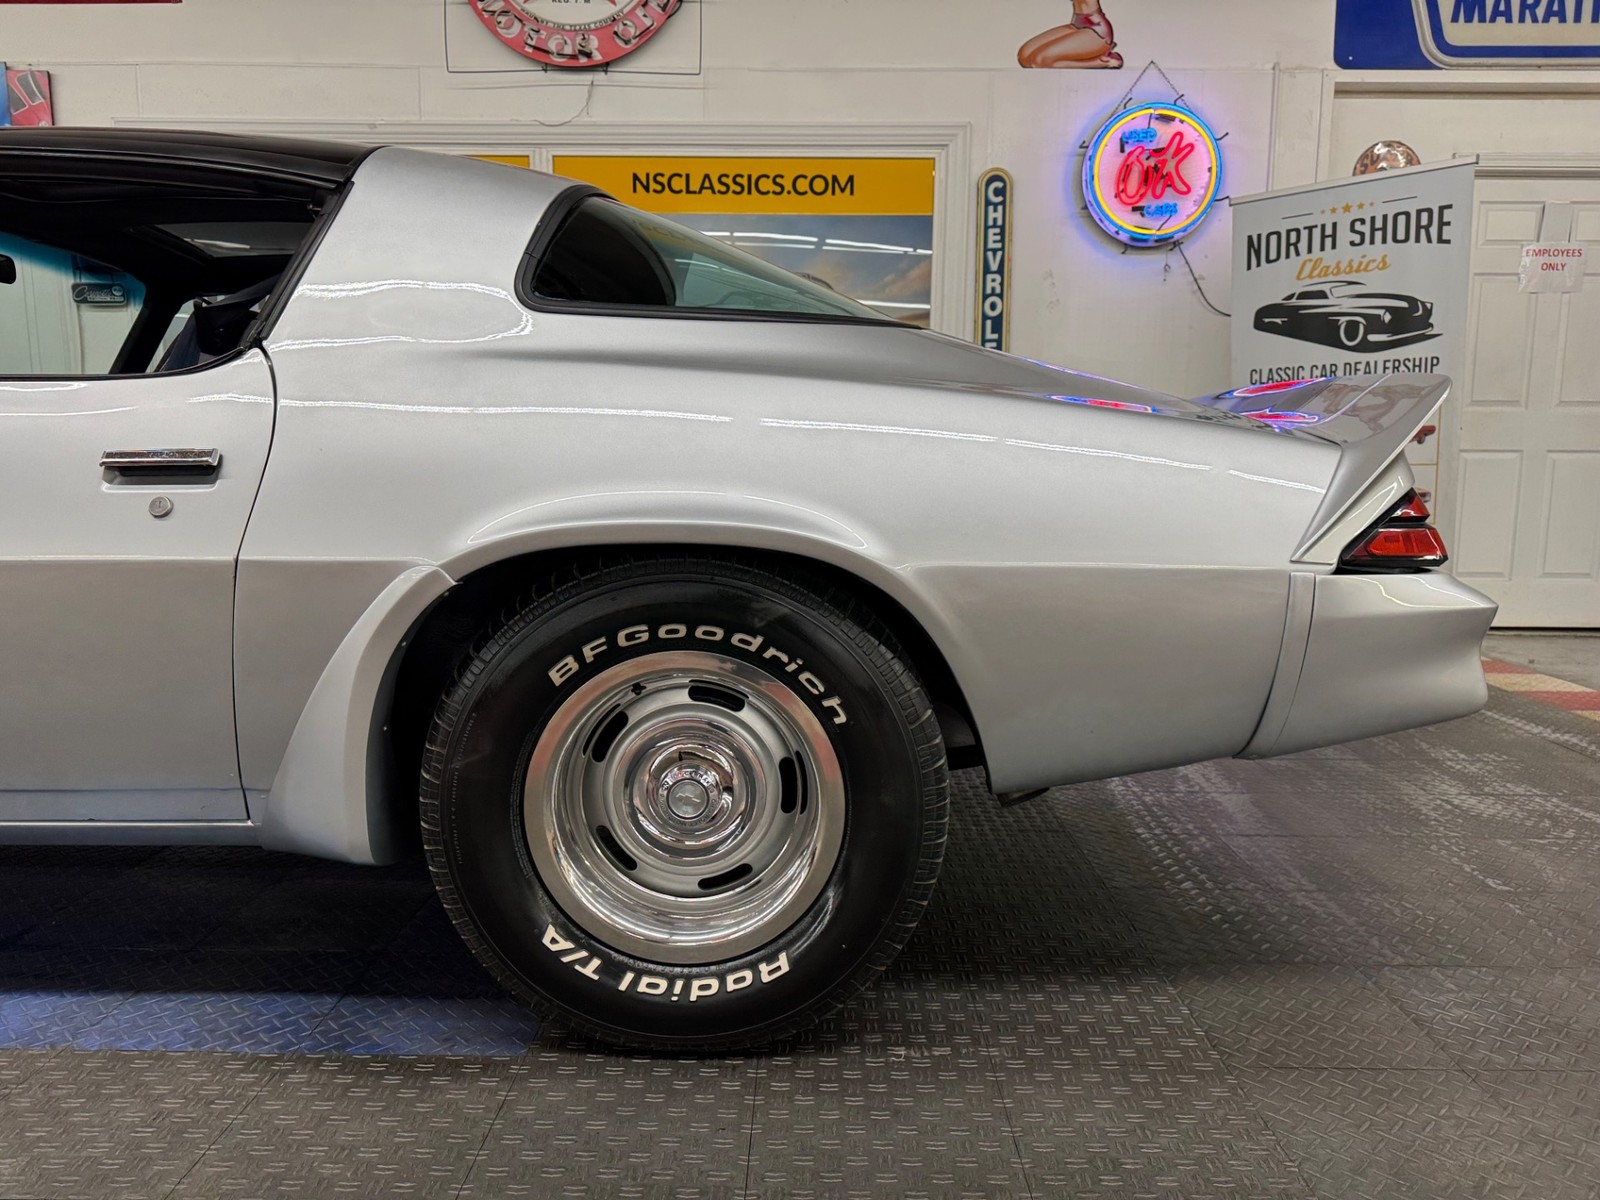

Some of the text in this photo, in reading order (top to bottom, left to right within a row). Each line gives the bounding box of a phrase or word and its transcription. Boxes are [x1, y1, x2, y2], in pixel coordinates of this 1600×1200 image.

[1121, 127, 1158, 143] USED
[1115, 131, 1195, 206] OK
[631, 172, 855, 197] NSCLASSICS.COM
[1246, 204, 1454, 271] NORTH SHORE
[1525, 248, 1583, 258] EMPLOYEES
[1295, 254, 1392, 281] Classics
[1541, 262, 1567, 272] ONLY
[1249, 355, 1441, 386] CLASSIC CAR DEALERSHIP
[547, 623, 849, 725] BFGoodrich
[541, 923, 603, 981] T/A
[617, 951, 791, 1002] Radial
